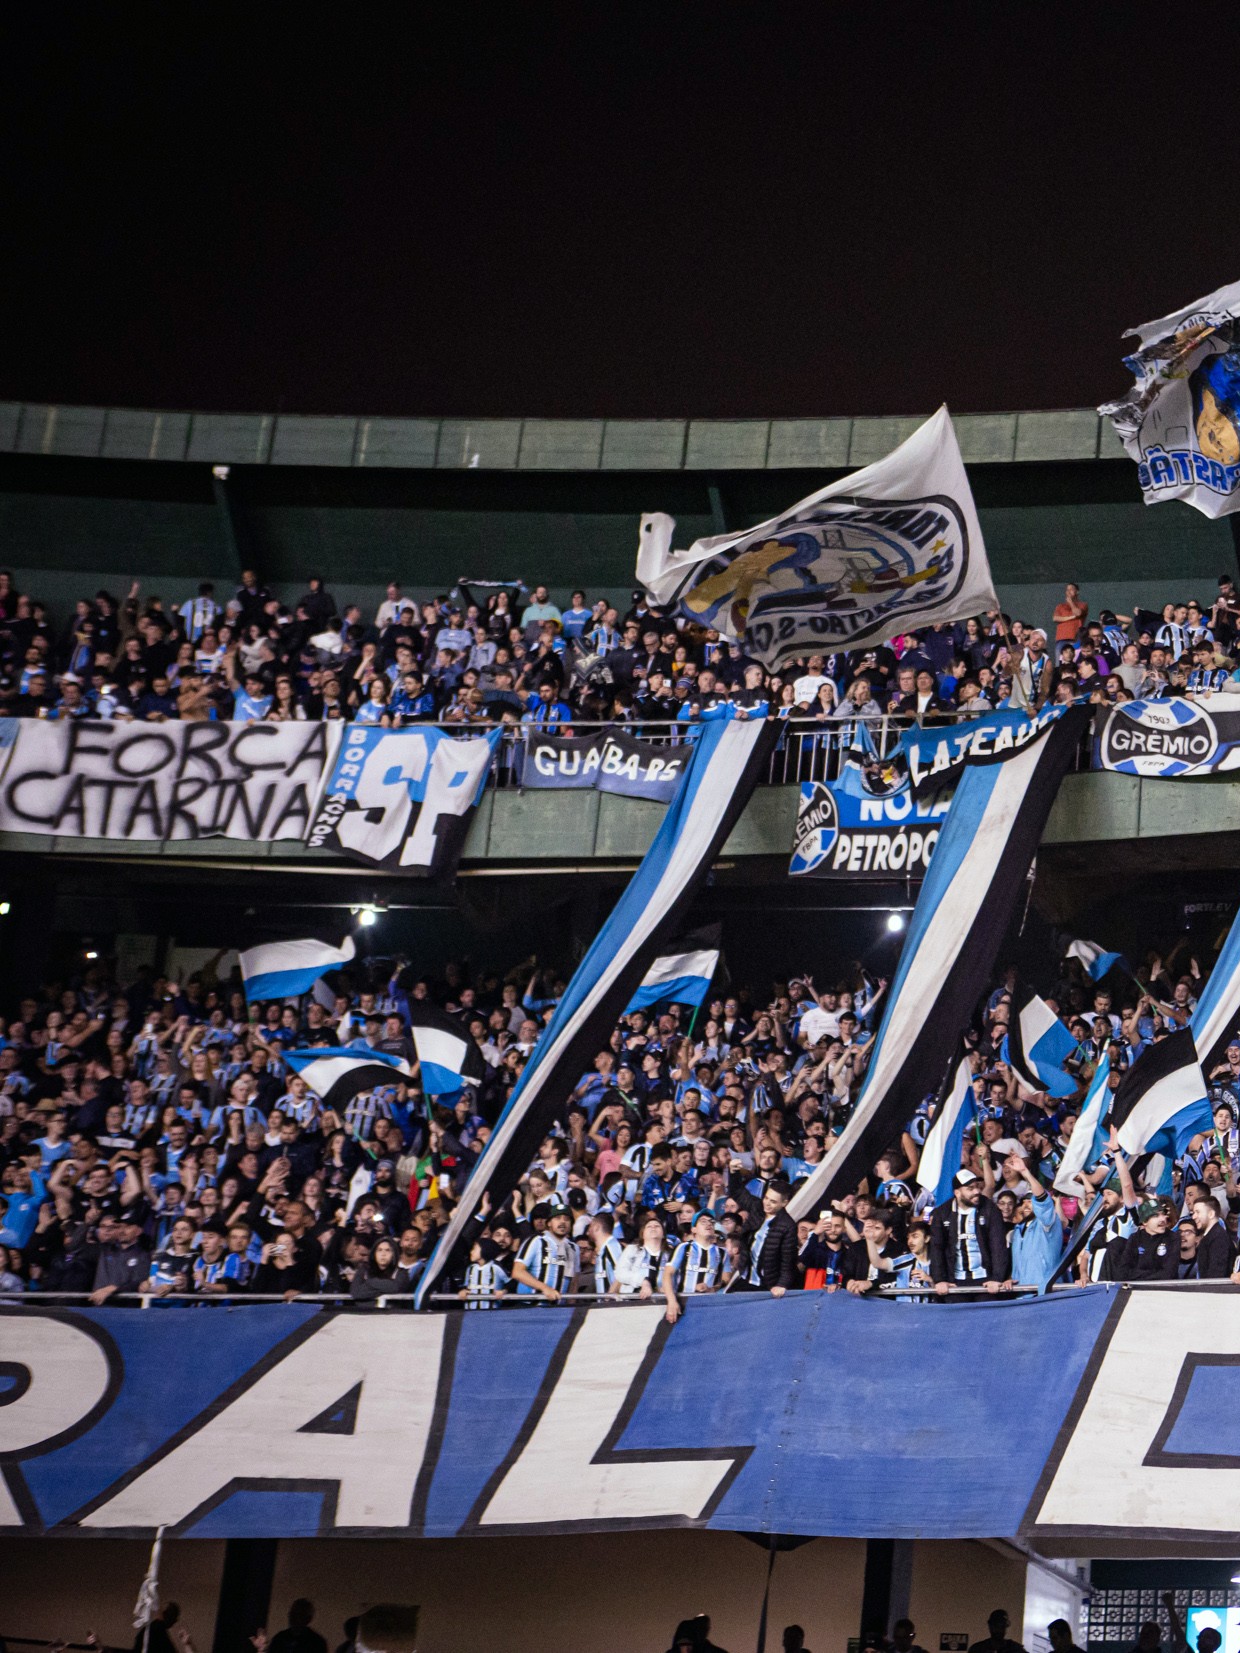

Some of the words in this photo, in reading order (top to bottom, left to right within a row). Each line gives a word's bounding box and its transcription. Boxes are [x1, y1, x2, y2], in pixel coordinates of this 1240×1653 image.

[62, 722, 329, 781] FORÇA
[1111, 729, 1209, 755] GRÊMIO
[4, 770, 315, 840] CATARINA
[307, 729, 369, 847] BORRACHOS
[336, 734, 491, 867] SP
